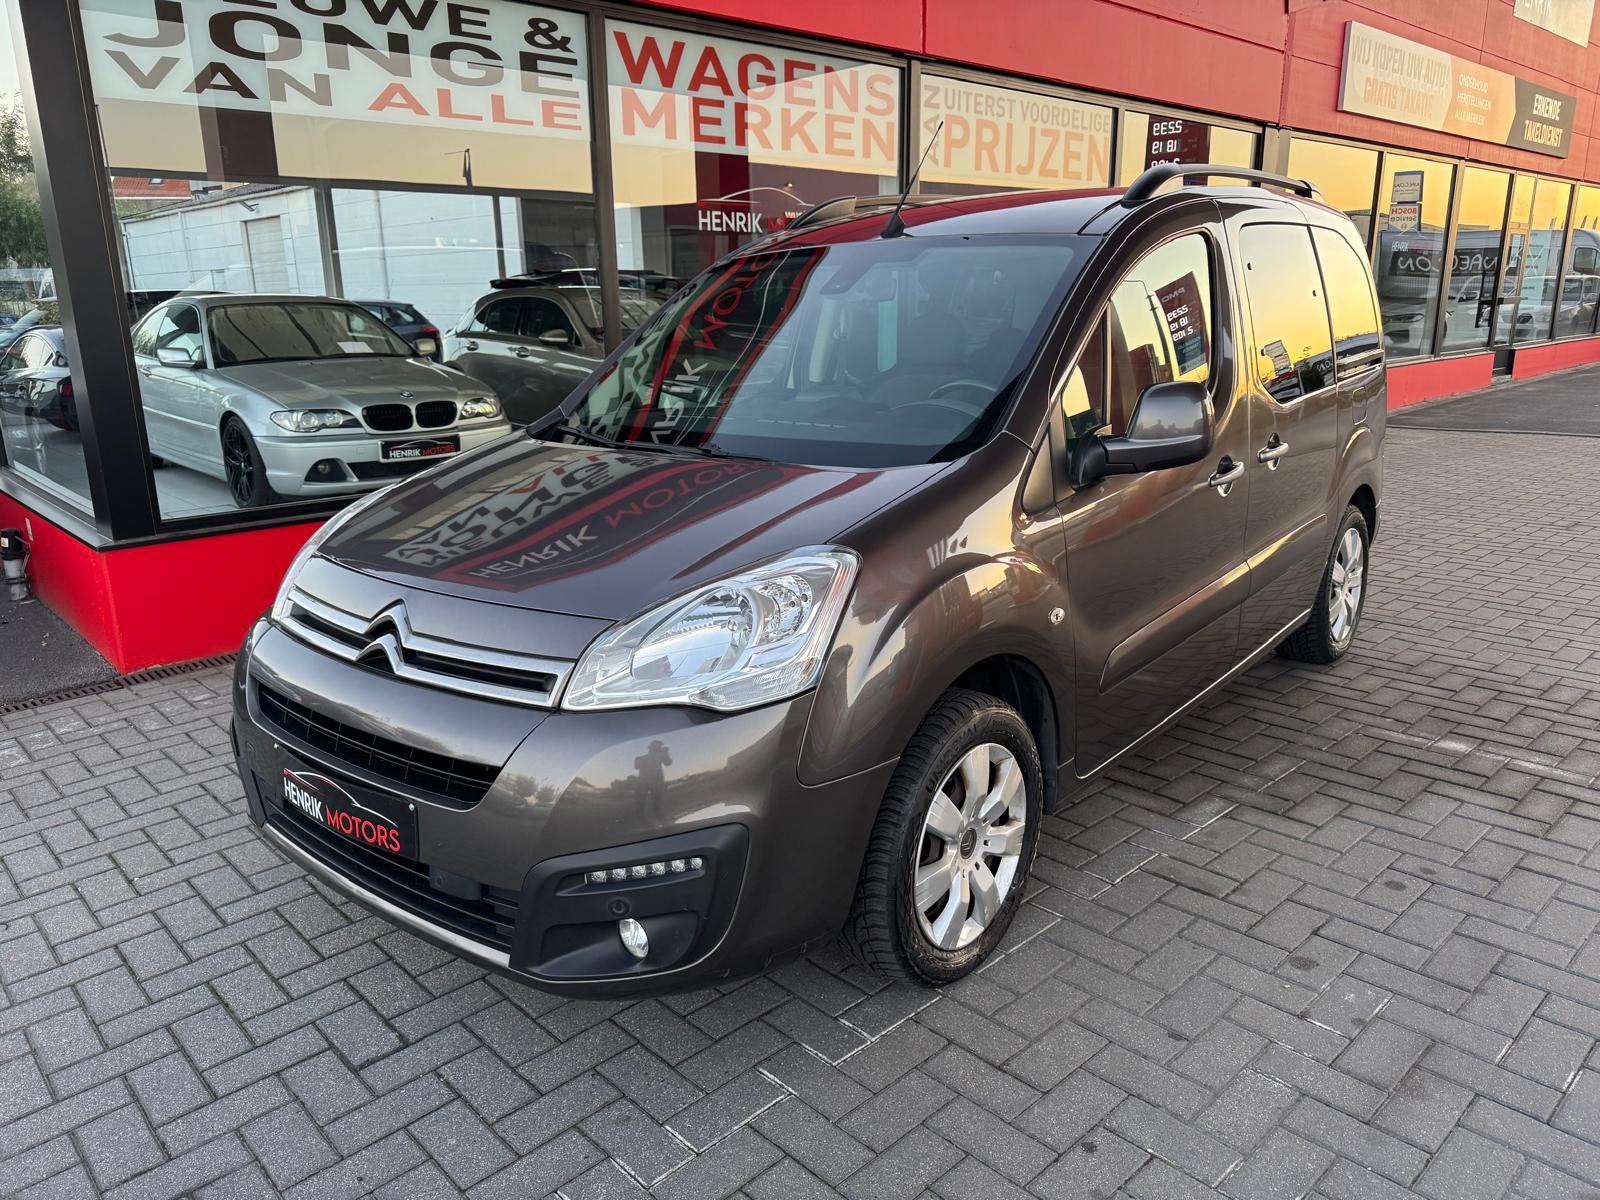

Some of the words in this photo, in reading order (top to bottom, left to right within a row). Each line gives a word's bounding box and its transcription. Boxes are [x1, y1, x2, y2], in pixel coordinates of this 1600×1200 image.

[102, 0, 580, 98] JONGE
[523, 17, 576, 54] &
[1352, 34, 1371, 65] WIJ
[1372, 40, 1405, 76] KOPEN
[1407, 51, 1425, 80] UW
[103, 49, 333, 107] VAN
[367, 82, 583, 131] ALLE
[612, 30, 895, 117] WAGENS
[1363, 76, 1398, 110] GRATIS
[620, 87, 895, 162] MERKEN
[944, 87, 1017, 119] UITERST
[1018, 99, 1110, 134] VOORDELIGE
[1533, 93, 1562, 121] ERKENDE
[943, 113, 1110, 183] PRIJZEN
[1523, 119, 1564, 148] TAKELDIENST
[698, 209, 763, 233] HENRIK
[389, 448, 421, 458] HENRIK
[422, 444, 456, 455] MOTORS
[283, 776, 324, 823] HENRIK
[325, 803, 401, 853] MOTORS
